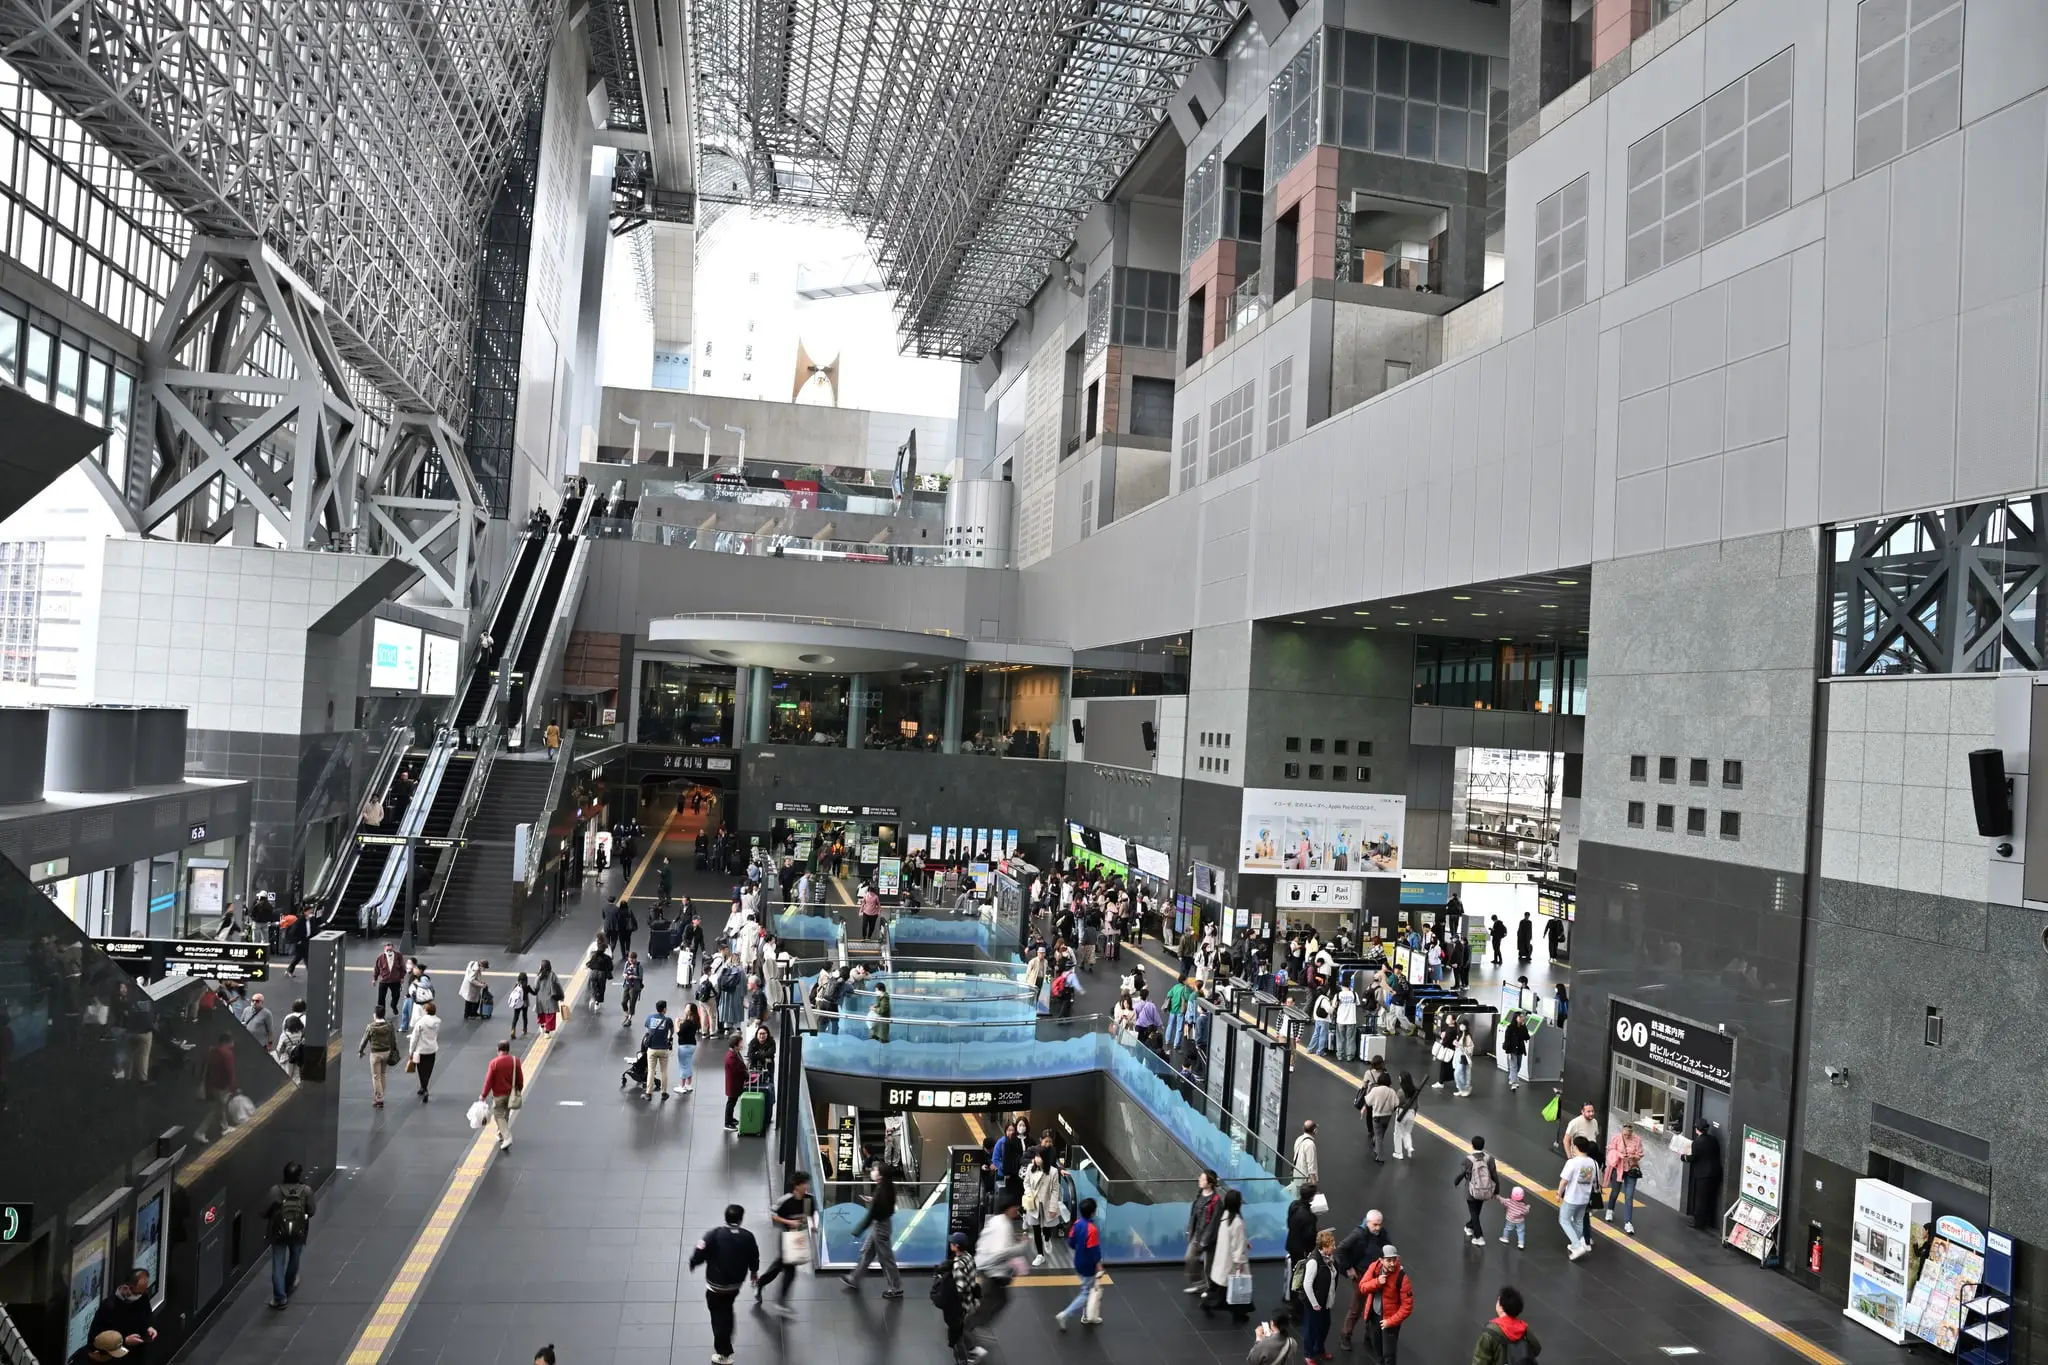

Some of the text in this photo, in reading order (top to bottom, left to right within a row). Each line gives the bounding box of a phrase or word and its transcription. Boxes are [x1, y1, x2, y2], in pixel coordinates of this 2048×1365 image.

[1652, 1020, 1685, 1039] 鉄道案内所
[1649, 1054, 1664, 1063] KYOTO
[1664, 1058, 1682, 1070] STATION
[1682, 1065, 1703, 1078] BUILDING
[1650, 1043, 1730, 1078] 駅ビルインフォメーション
[890, 1089, 913, 1104] B1F
